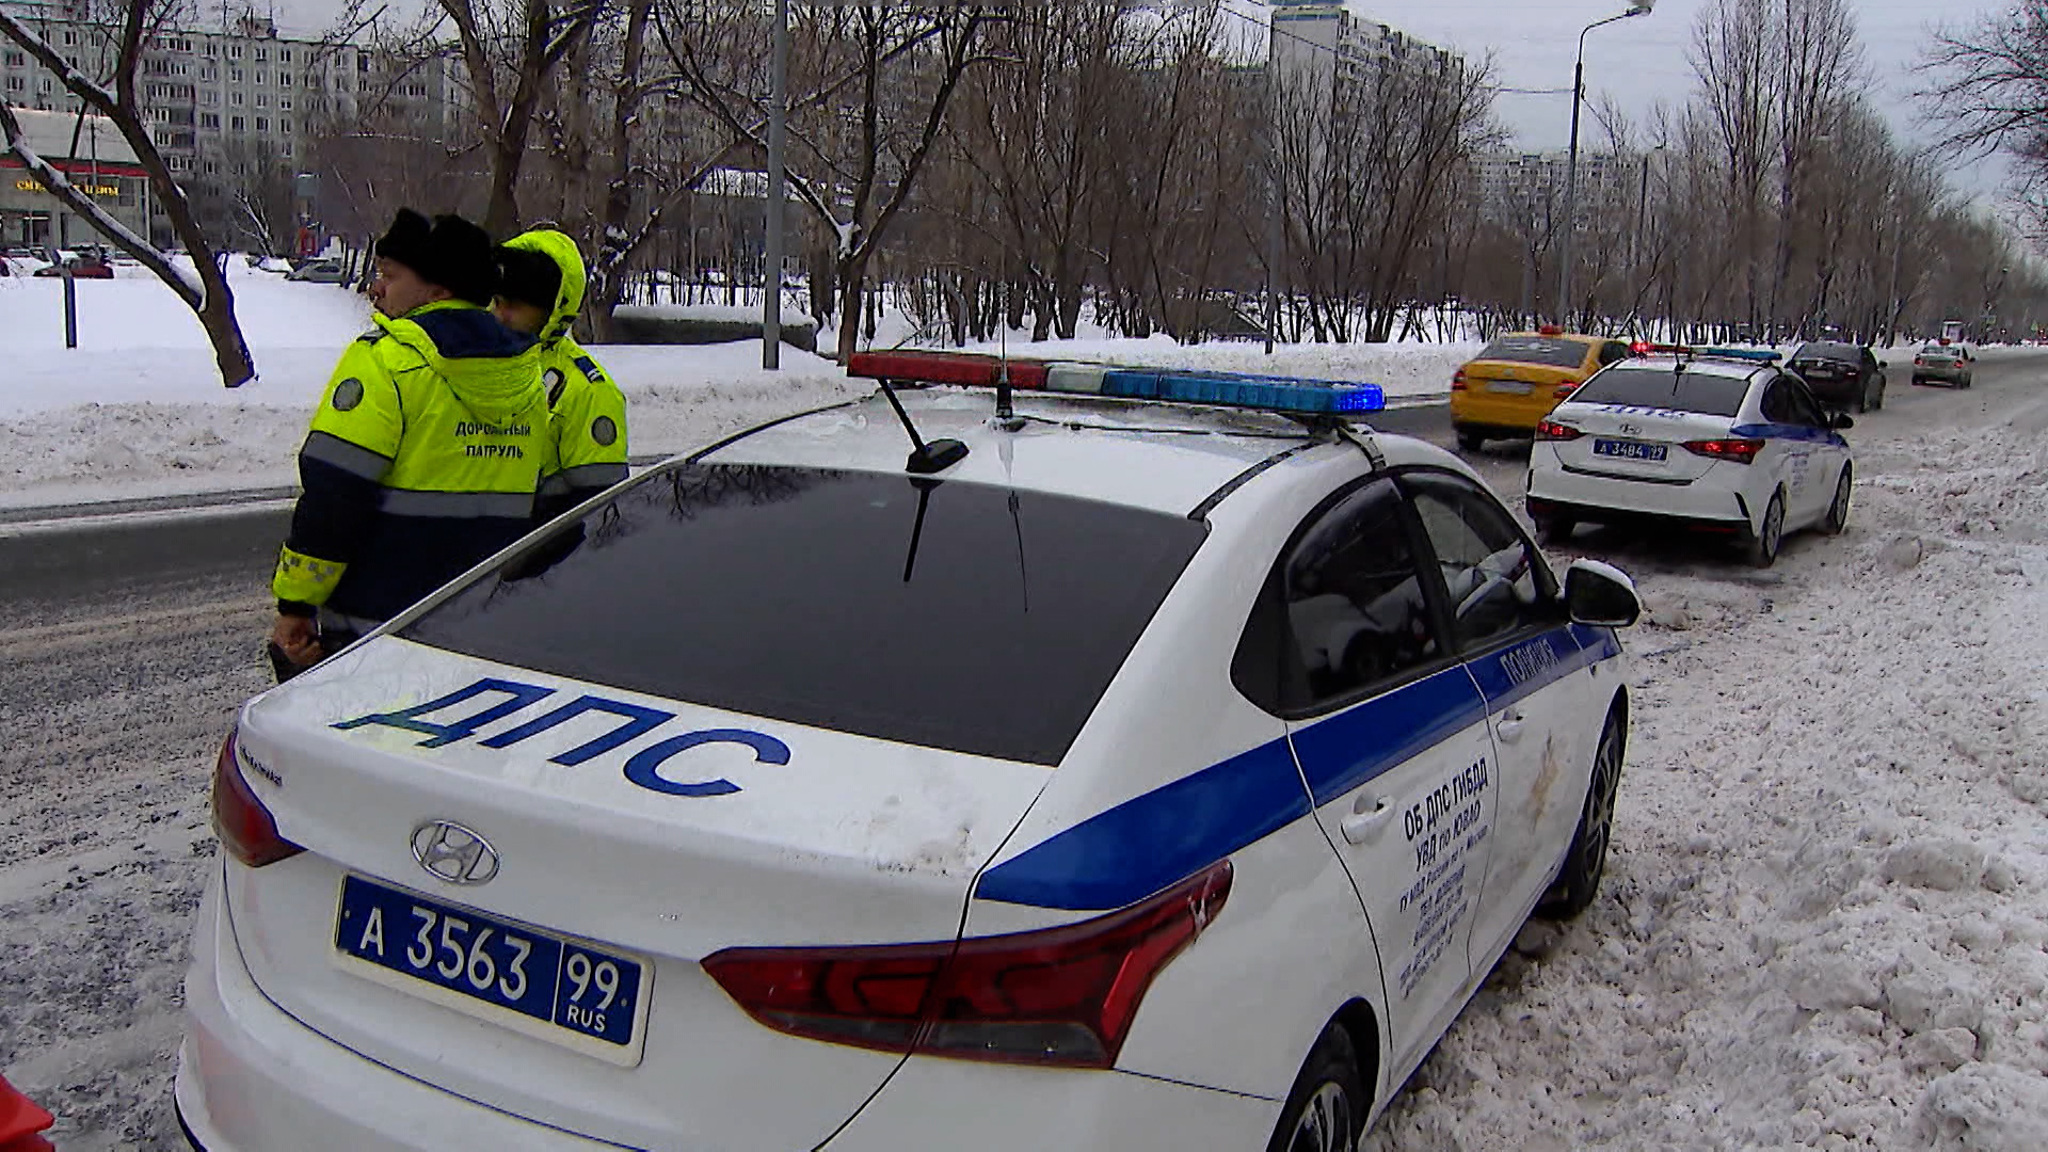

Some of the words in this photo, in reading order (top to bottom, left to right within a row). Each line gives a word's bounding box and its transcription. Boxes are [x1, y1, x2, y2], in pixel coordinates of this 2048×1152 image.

[466, 445, 524, 459] ПАТРУЛЬ
[328, 677, 791, 798] ДПС
[1404, 803, 1423, 842] ОБ
[1426, 784, 1451, 832] ДПС
[1452, 757, 1488, 805] ГИБДД
[1416, 833, 1437, 872] УВД
[1453, 800, 1481, 840] ЮВАО
[407, 905, 531, 1001] 3563
[566, 952, 620, 1010] 99
[566, 1004, 607, 1034] RUS
